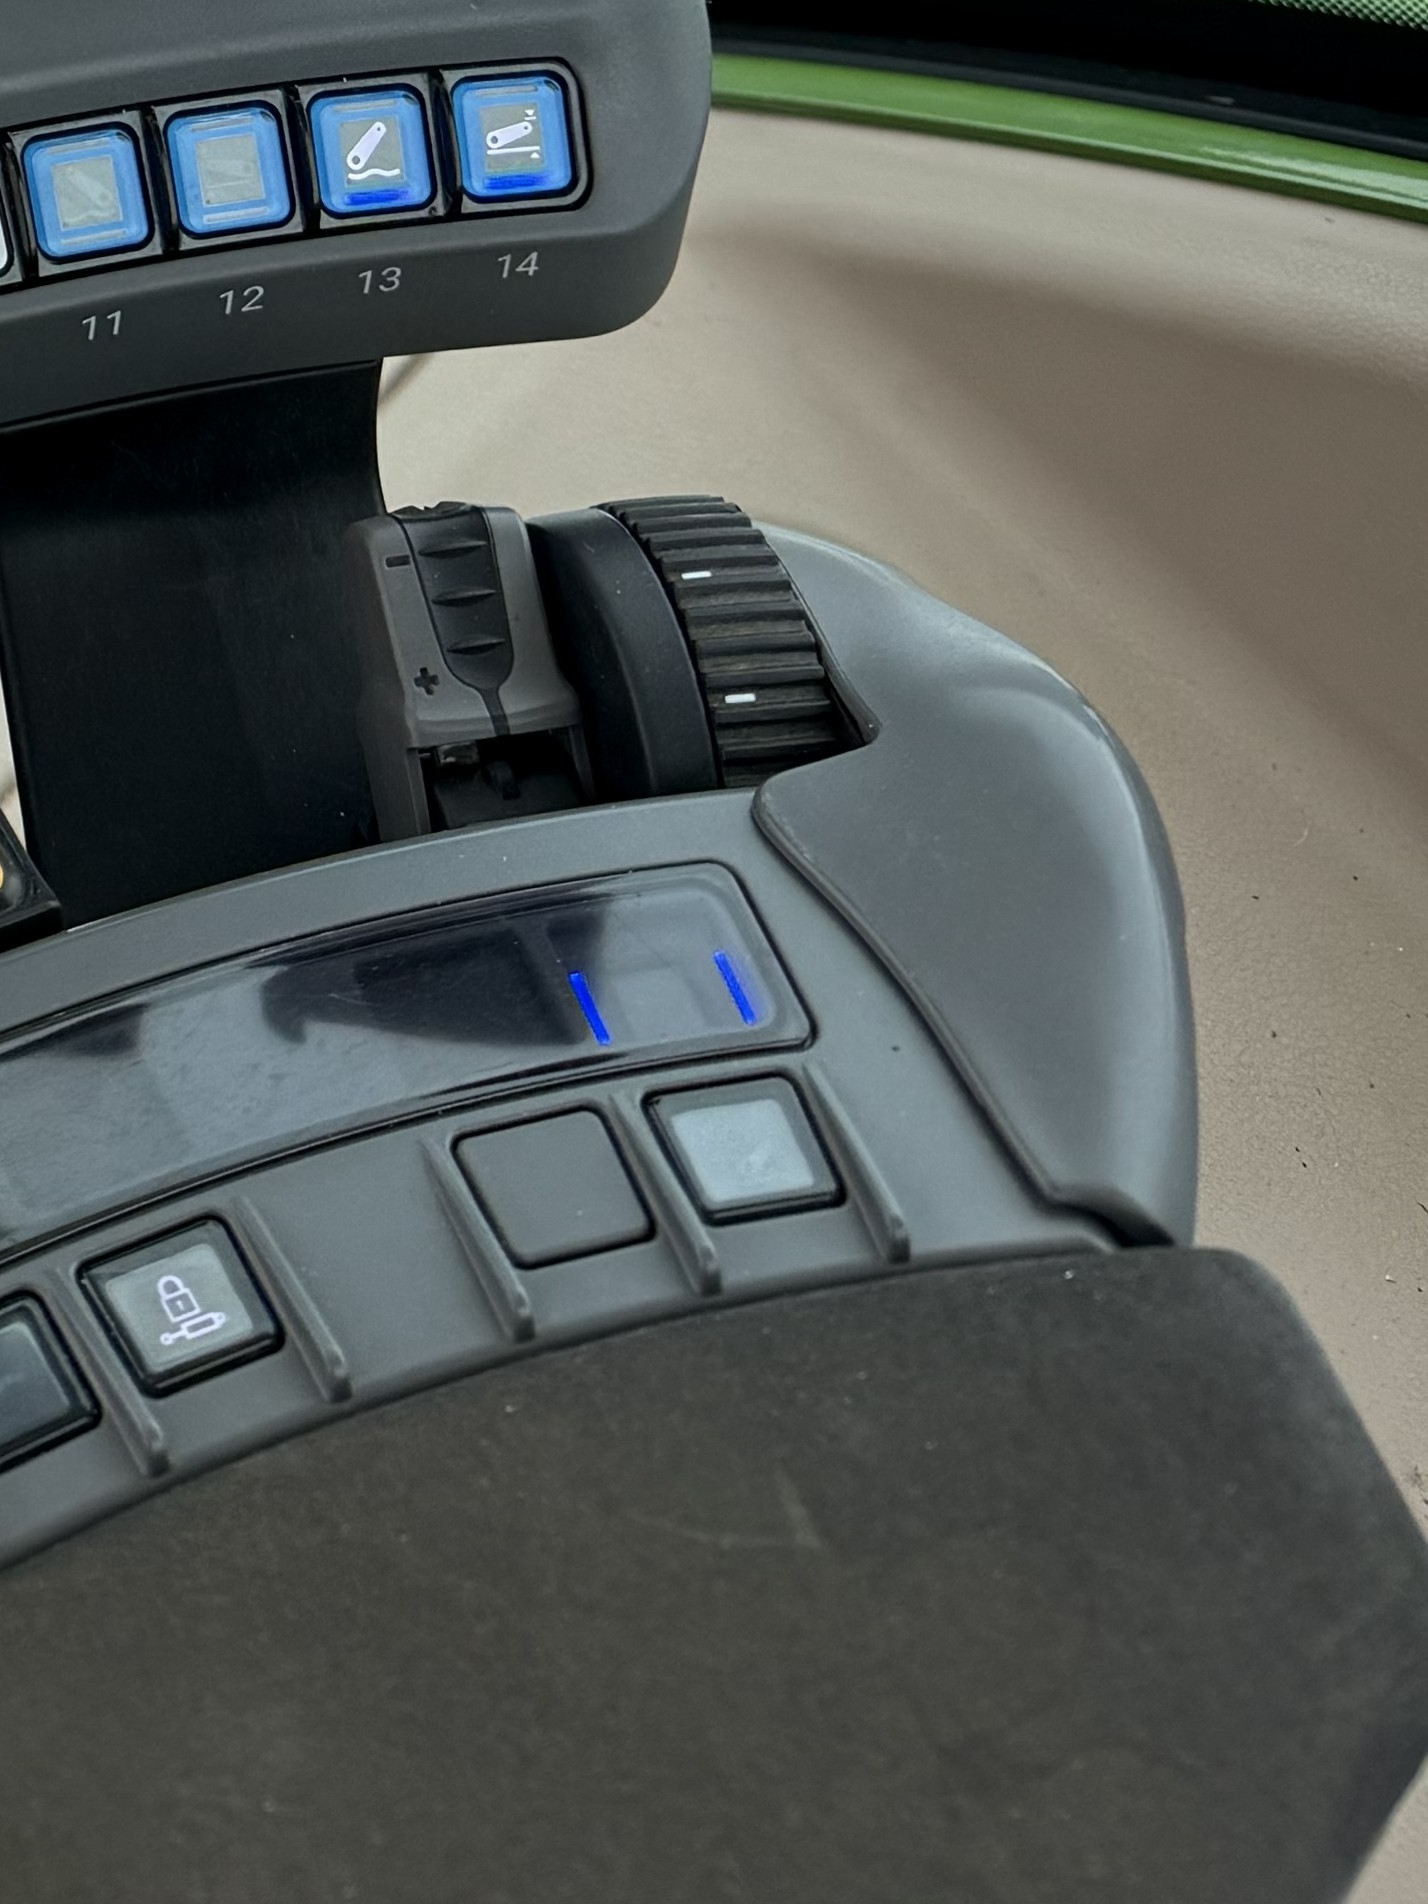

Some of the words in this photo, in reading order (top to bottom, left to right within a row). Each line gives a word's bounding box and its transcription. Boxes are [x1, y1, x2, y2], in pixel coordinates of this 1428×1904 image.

[496, 251, 540, 279] 14
[357, 266, 403, 295] 13
[219, 285, 266, 316] 12
[81, 309, 123, 341] 11
